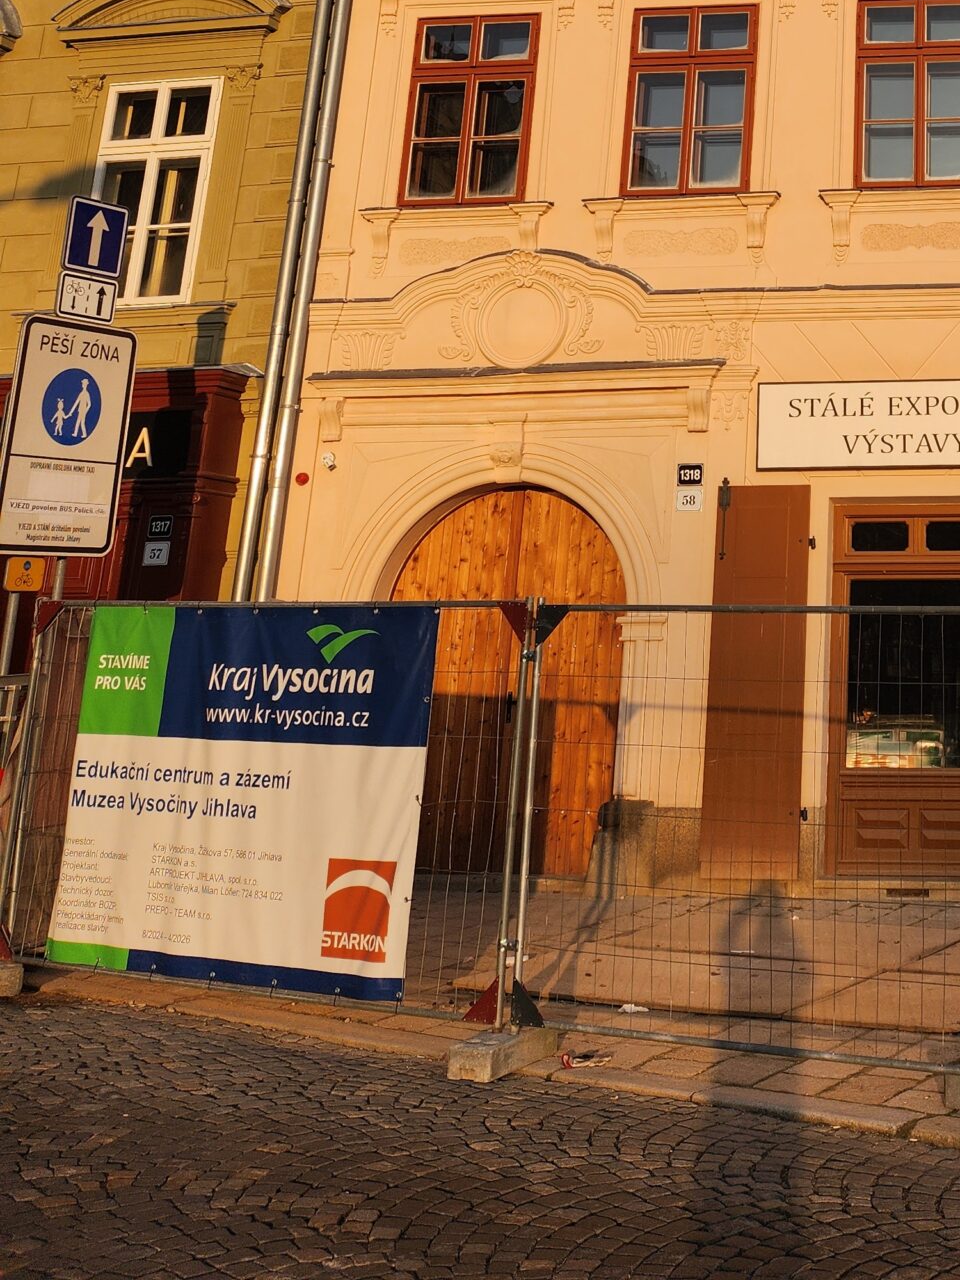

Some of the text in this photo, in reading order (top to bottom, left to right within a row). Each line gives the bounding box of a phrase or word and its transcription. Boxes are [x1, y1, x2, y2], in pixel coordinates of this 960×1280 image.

[40, 331, 119, 362] PĚŠÍ ZÓNA
[788, 392, 874, 418] STÁLÉ
[680, 469, 700, 480] 1318
[31, 504, 58, 512] povolen
[682, 495, 696, 506] 58
[151, 521, 170, 532] 1317
[149, 549, 163, 560] 57
[98, 652, 150, 670] STAVÍME
[94, 674, 147, 690] PRO VÁS
[208, 663, 257, 701] Kraj
[206, 703, 369, 731] www.kr-vysocina.cz
[75, 759, 292, 790] Edukační centrum a zázemí
[71, 789, 257, 820] Muzea Vysočiny Jihlava
[153, 841, 167, 854] Kraj
[247, 850, 256, 860] 01
[253, 890, 268, 899] 834
[269, 891, 283, 901] 022
[174, 908, 196, 919] TEAM
[321, 930, 388, 953] STARKON
